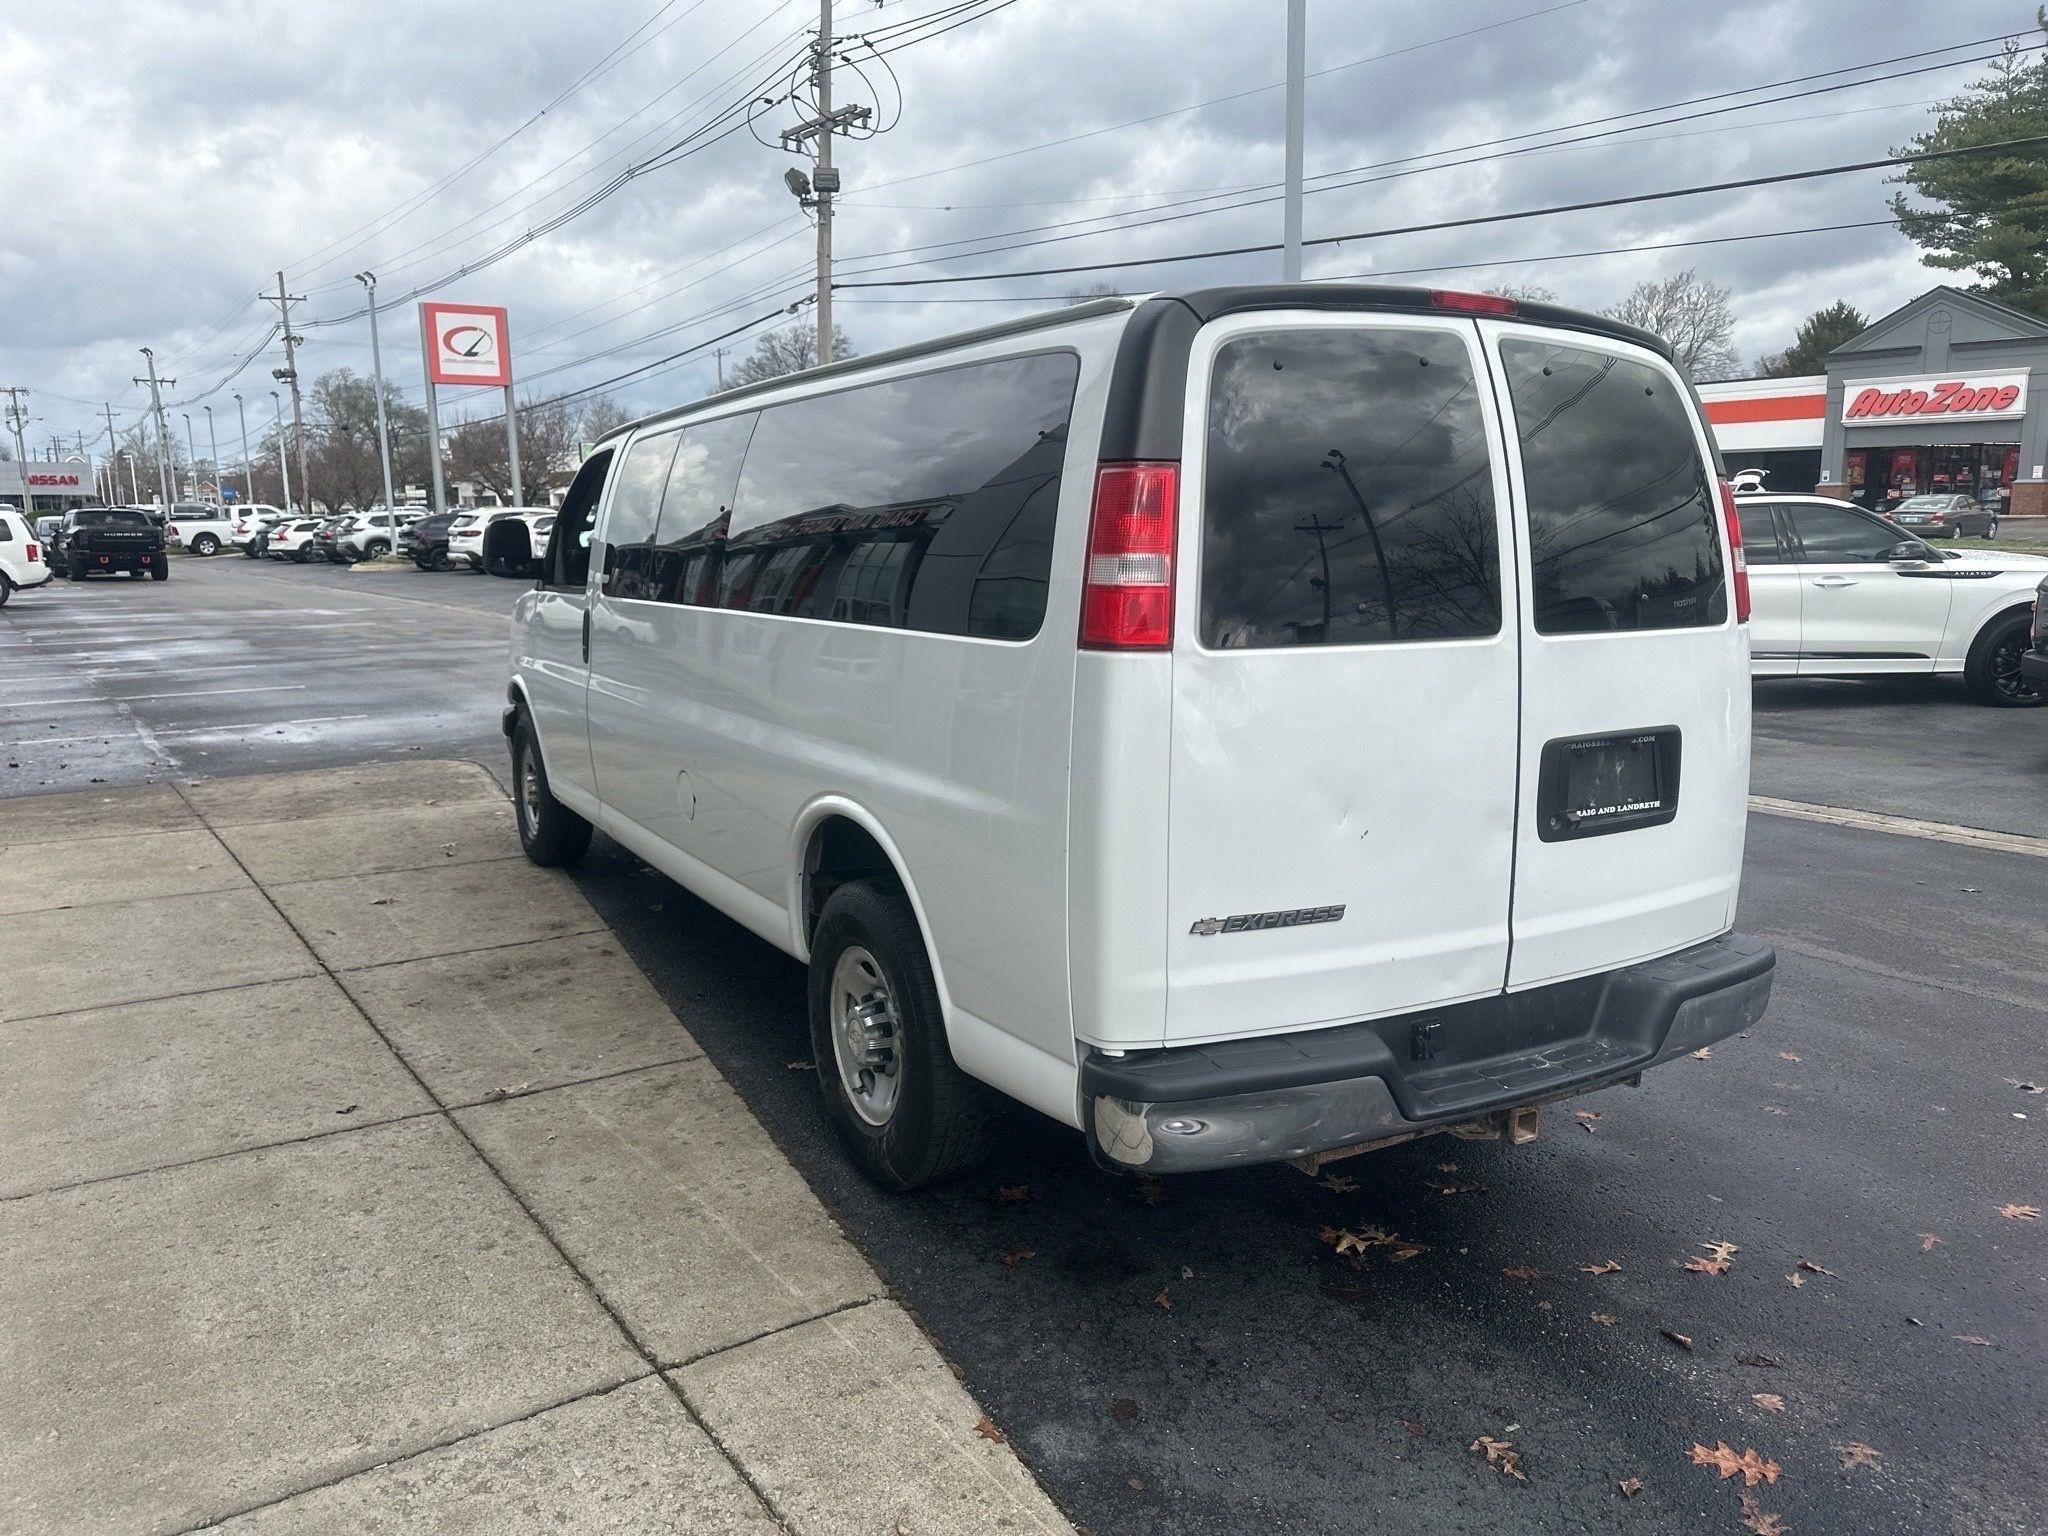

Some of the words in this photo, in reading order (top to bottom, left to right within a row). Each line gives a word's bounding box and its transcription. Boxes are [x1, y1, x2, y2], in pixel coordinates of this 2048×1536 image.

[1846, 381, 2020, 418] AutoZone
[1575, 808, 1597, 817] RAIG
[1597, 806, 1616, 815] AND
[1617, 800, 1661, 812] LANDRETH
[1221, 904, 1347, 934] EXPRESS
